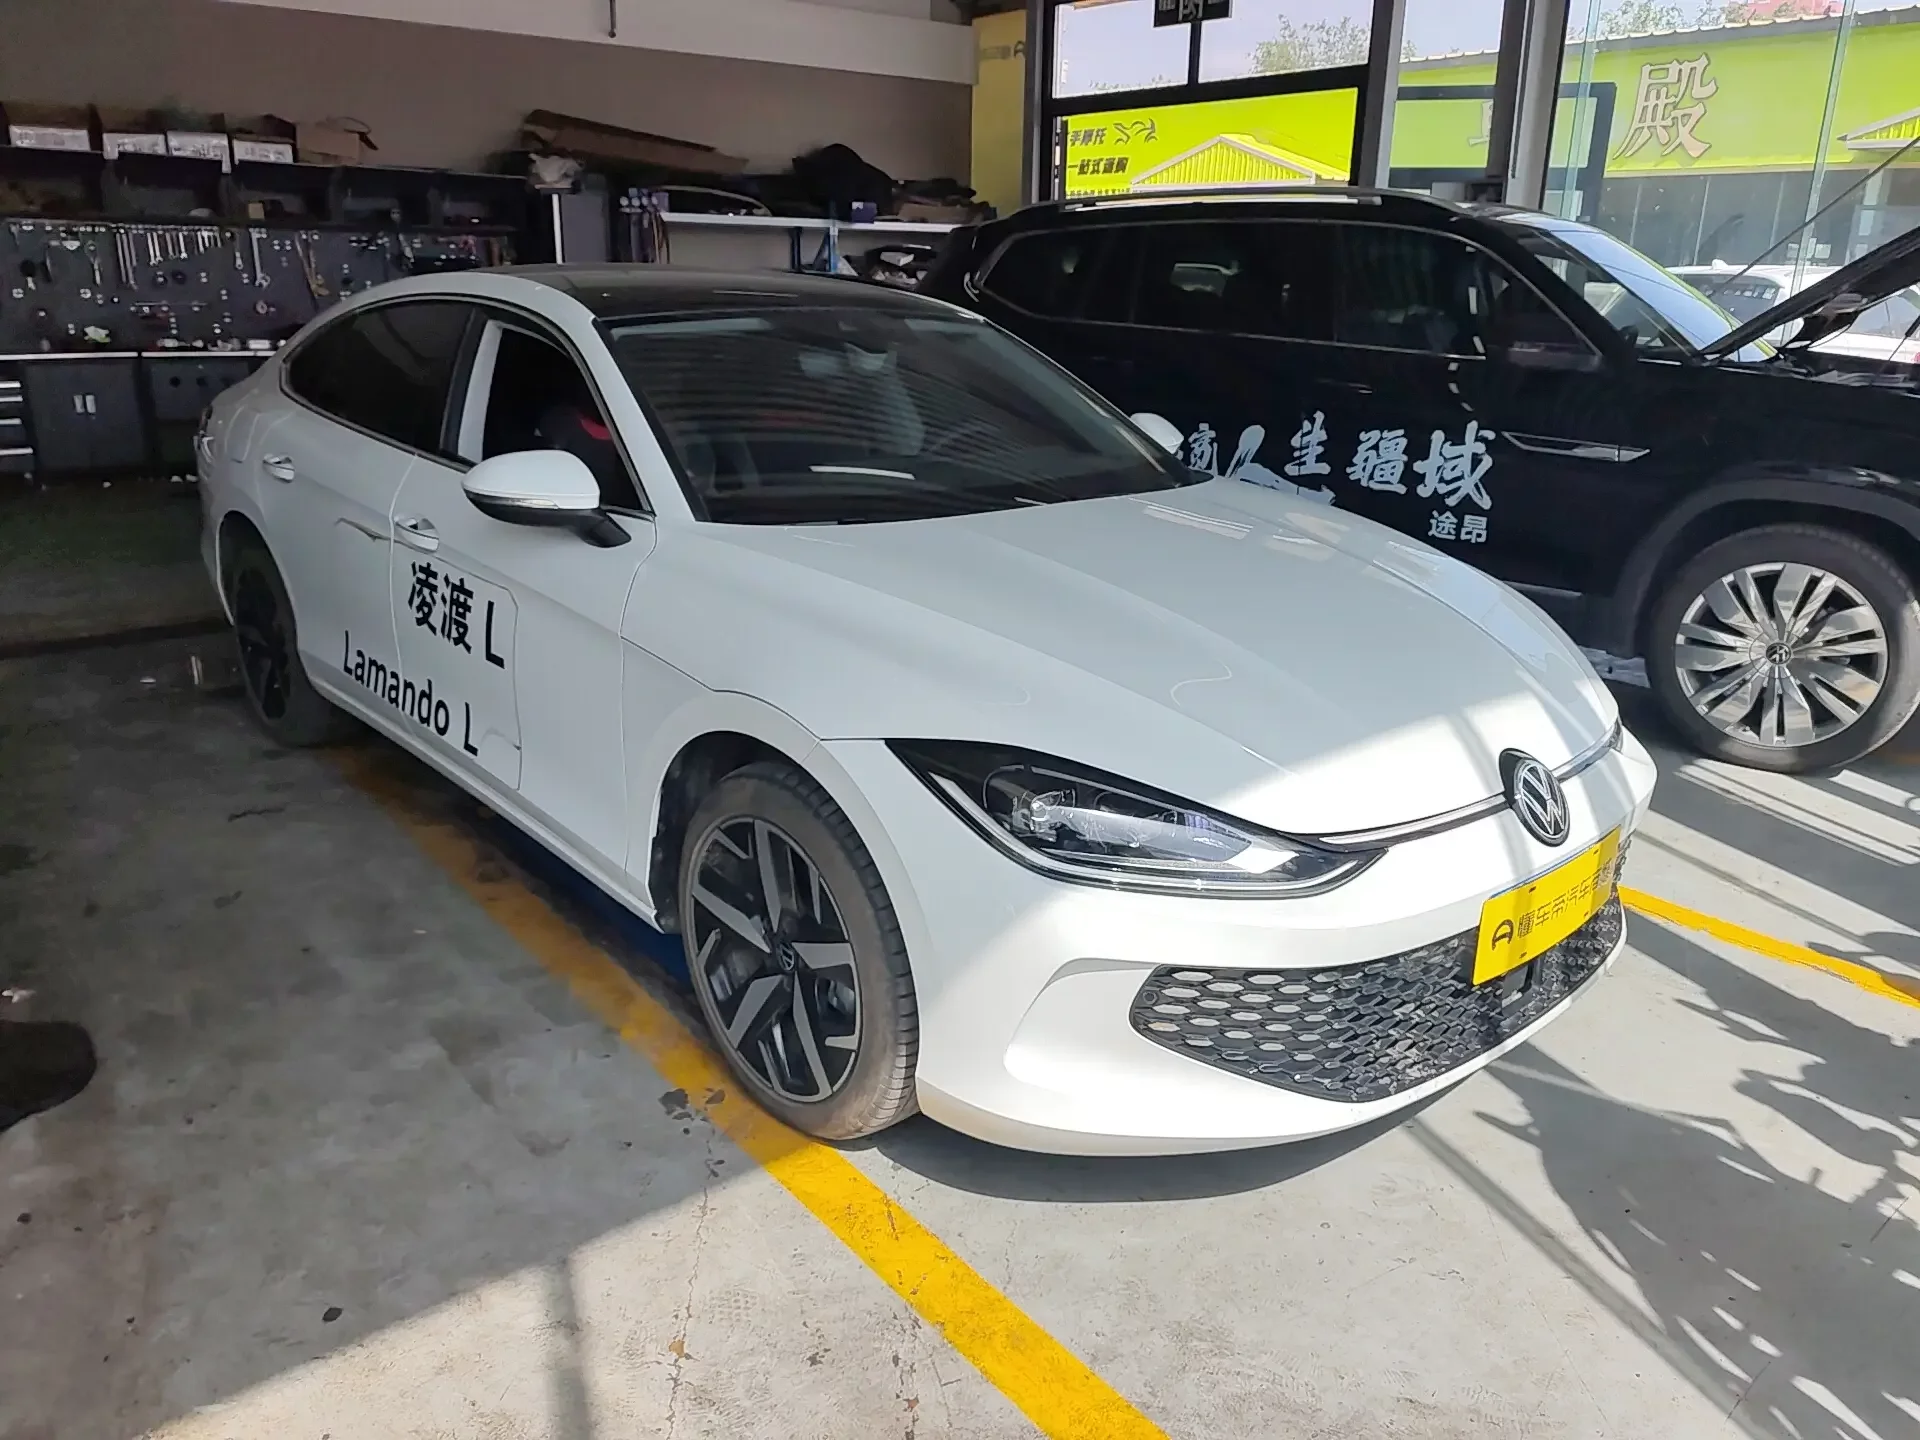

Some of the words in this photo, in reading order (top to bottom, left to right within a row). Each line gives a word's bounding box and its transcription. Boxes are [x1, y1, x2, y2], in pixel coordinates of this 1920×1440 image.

[1612, 52, 1719, 160] 殿
[1175, 410, 1497, 510] 宽人生疆域
[1428, 510, 1488, 543] 途昂
[408, 561, 475, 655] 凌渡
[485, 600, 505, 669] L
[344, 630, 450, 736] Lamando
[463, 701, 479, 757] L
